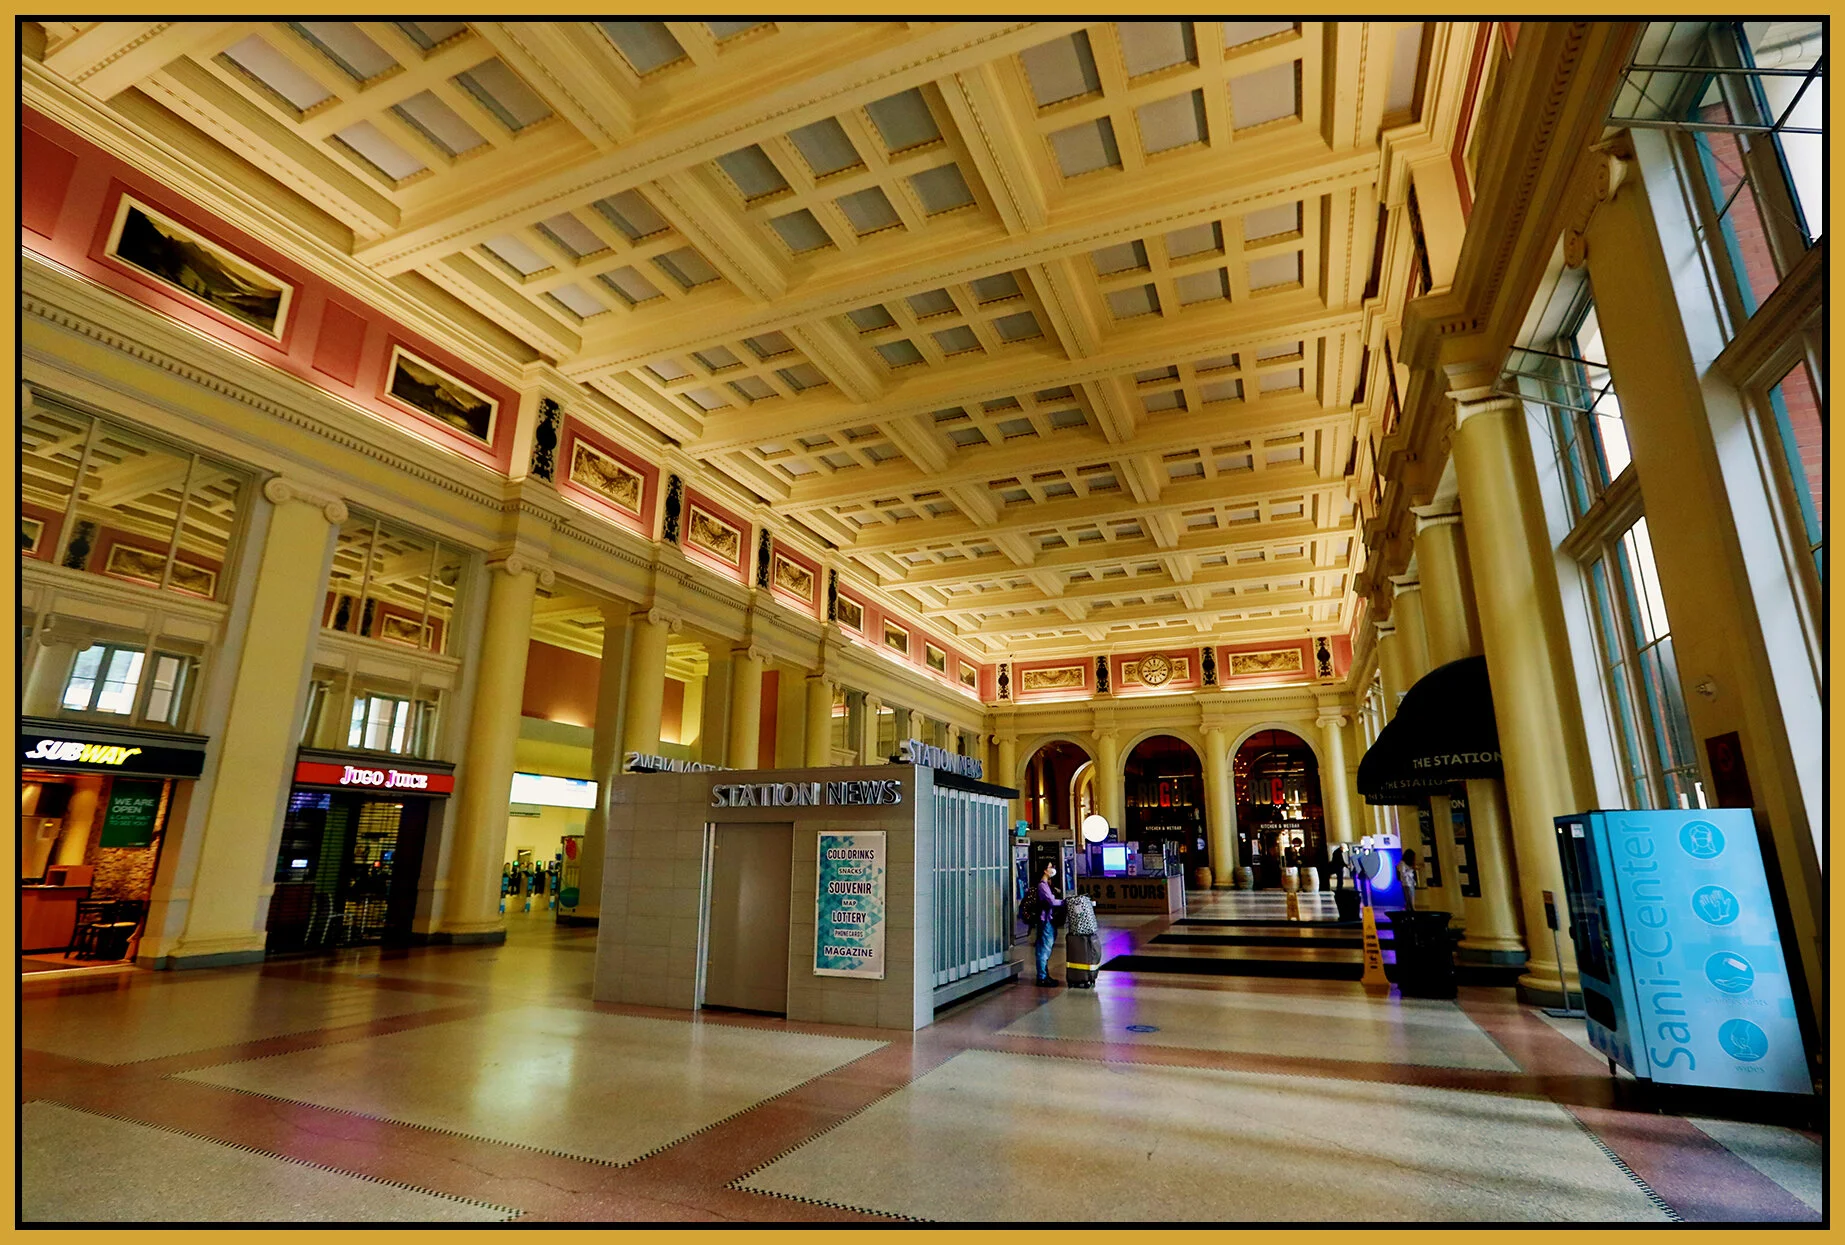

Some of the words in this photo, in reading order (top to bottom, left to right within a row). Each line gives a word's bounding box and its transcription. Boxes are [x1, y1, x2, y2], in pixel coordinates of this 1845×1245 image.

[25, 740, 142, 765] SUBWAY
[906, 738, 959, 773] STATION
[960, 755, 984, 780] NEWS
[1413, 758, 1431, 769] THE
[340, 765, 384, 785] JUGO
[385, 769, 428, 788] JUICE
[711, 782, 820, 807] STATION
[825, 779, 902, 806] NEWS
[1138, 781, 1193, 807] ROGUE
[1249, 777, 1309, 805] ROGUE
[112, 805, 143, 814] OPEN
[115, 797, 132, 806] WE
[133, 798, 155, 807] ARE
[827, 849, 846, 860] COLD
[847, 849, 875, 860] DRINKS
[828, 882, 872, 895] SOUVENIR
[1106, 884, 1116, 899] &
[1121, 884, 1165, 900] TOURS
[832, 911, 867, 923] LOTTERY
[824, 946, 874, 958] MAGAZINE
[1619, 819, 1696, 1072] Sani-Center
